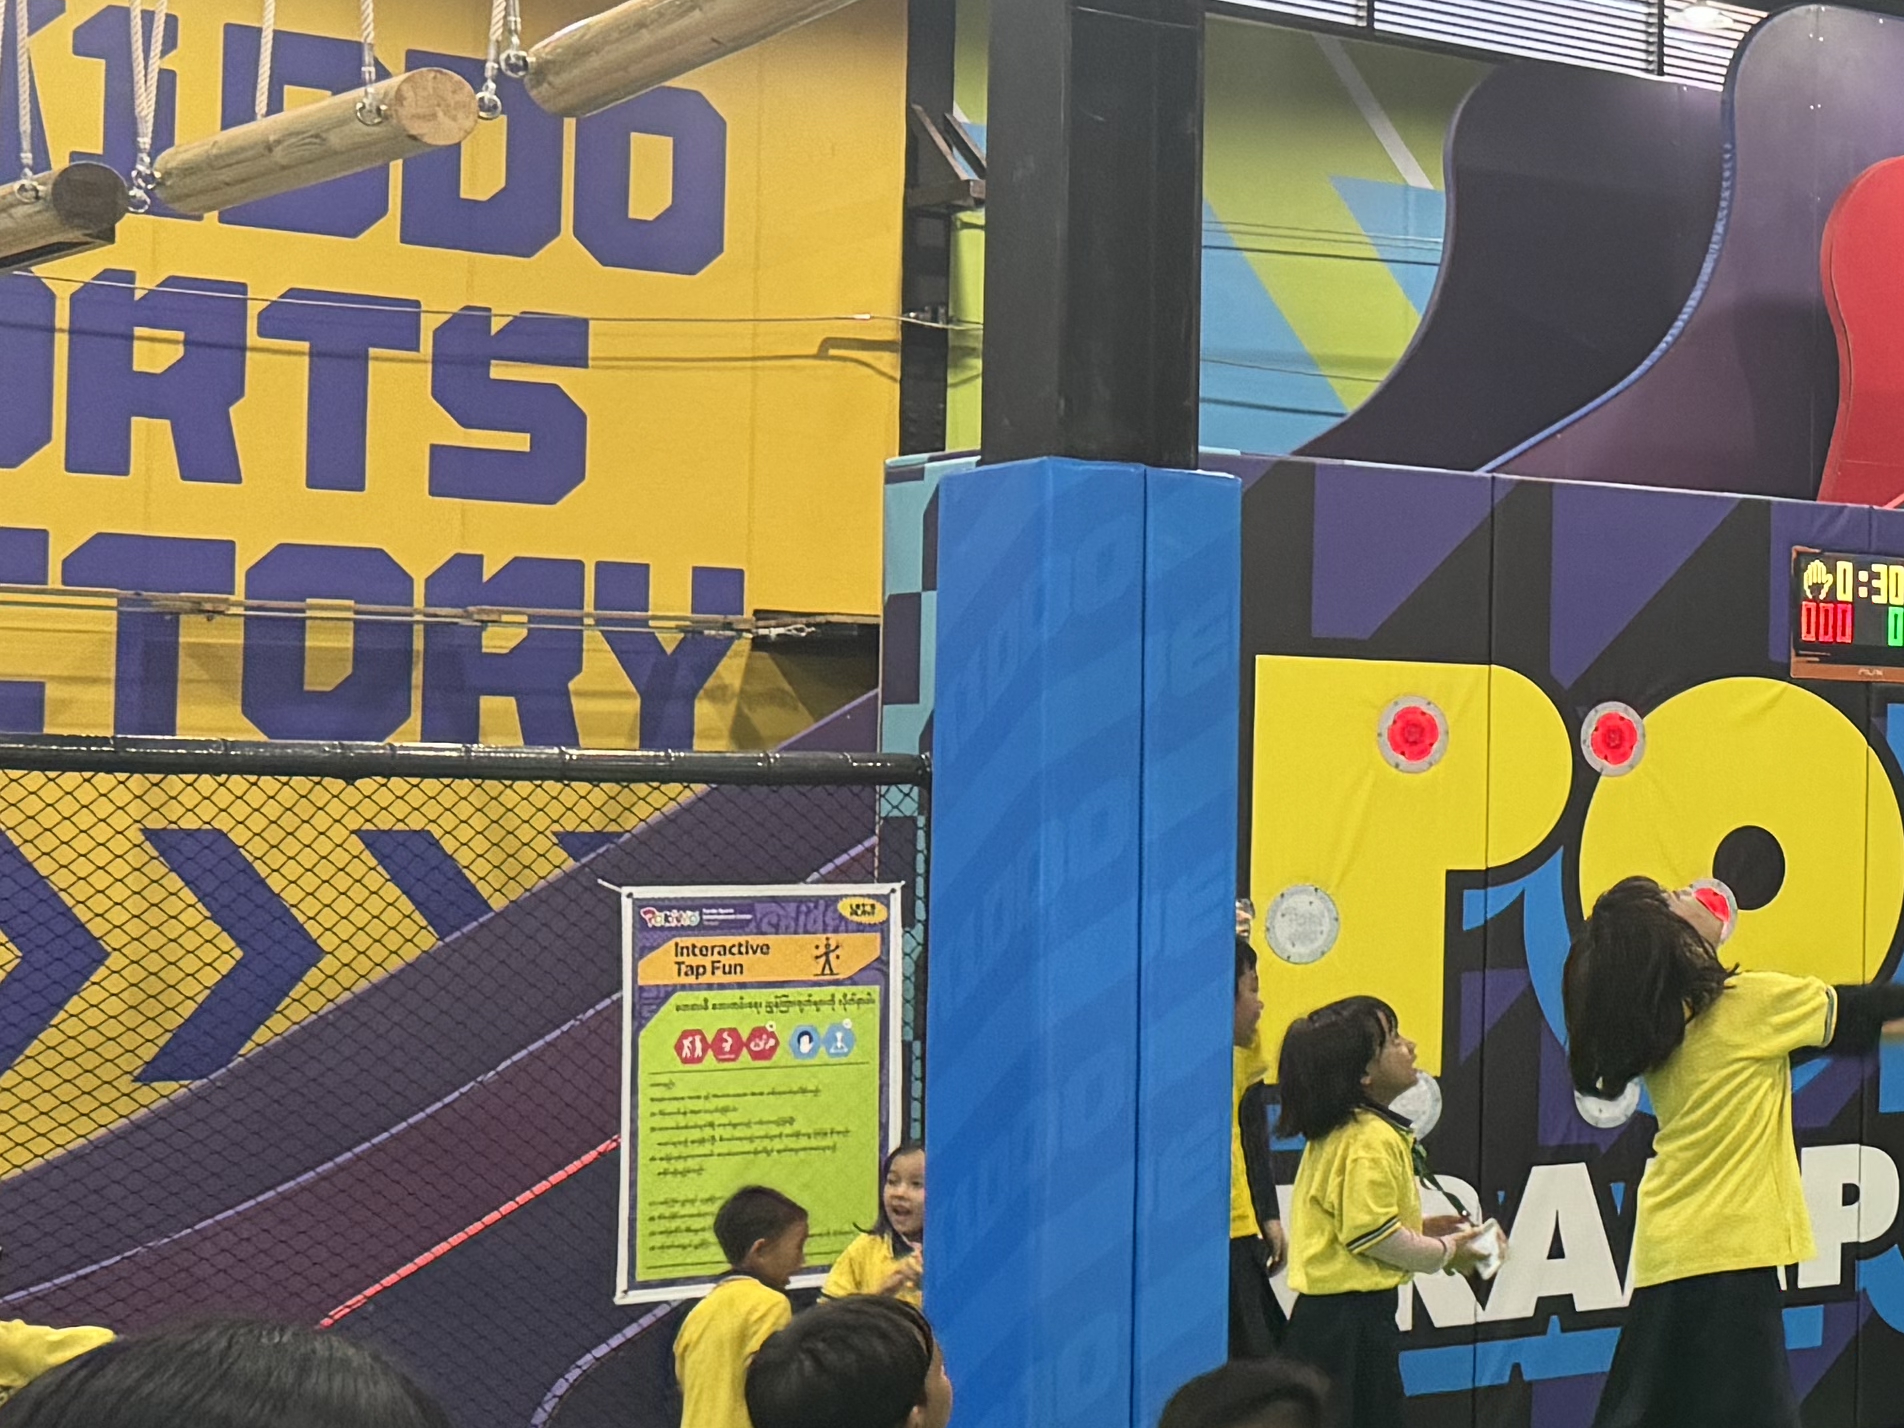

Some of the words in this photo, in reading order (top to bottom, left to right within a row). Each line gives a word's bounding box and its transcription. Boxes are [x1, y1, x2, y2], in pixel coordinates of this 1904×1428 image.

[674, 941, 771, 958] Interactive
[674, 961, 706, 980] Tap
[711, 960, 744, 976] Fun
